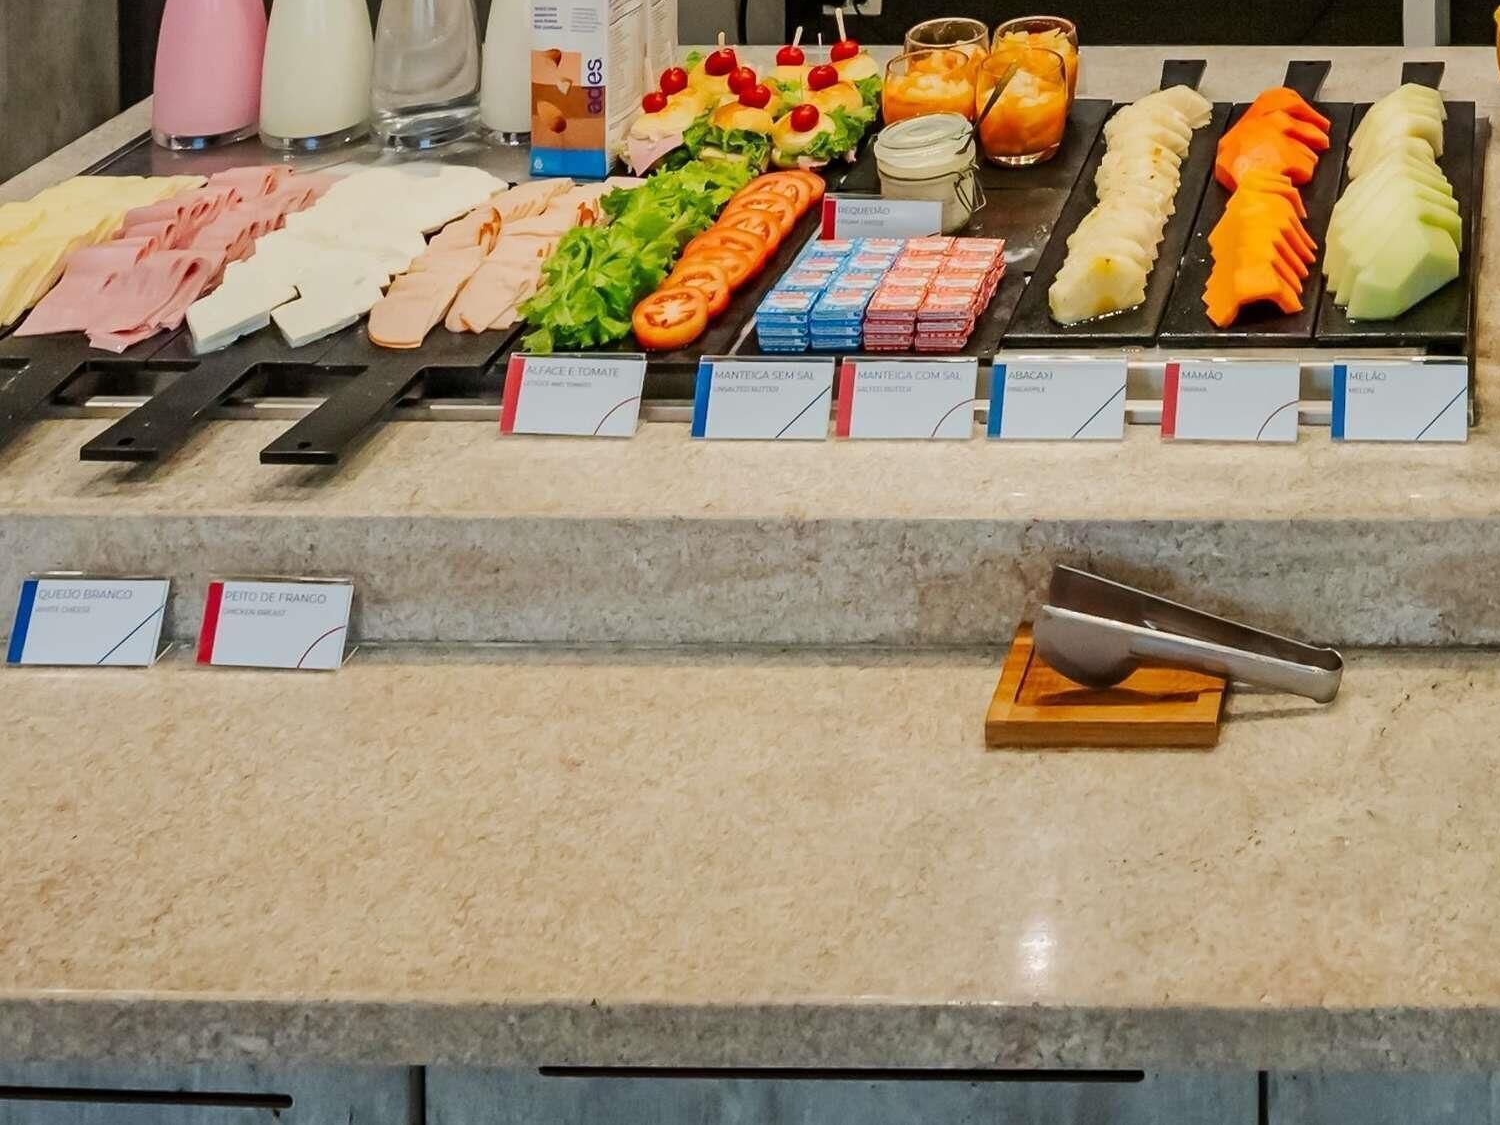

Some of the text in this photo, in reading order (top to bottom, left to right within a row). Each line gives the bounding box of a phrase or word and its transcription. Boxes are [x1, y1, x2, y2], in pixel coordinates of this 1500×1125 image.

[587, 58, 602, 114] ades
[526, 364, 564, 377] ALFACE
[576, 366, 620, 378] TOMATE
[714, 370, 816, 381] MANTEIGA SEM SAL
[857, 370, 961, 381] MANTEIGA COM SAL
[1008, 370, 1055, 380] ABACAXI
[1181, 369, 1223, 381] MAMÃO
[1348, 370, 1386, 382] MELÃO
[38, 588, 133, 600] QUEIJO BRANCO
[224, 590, 327, 605] PEITO DE FRANGO
